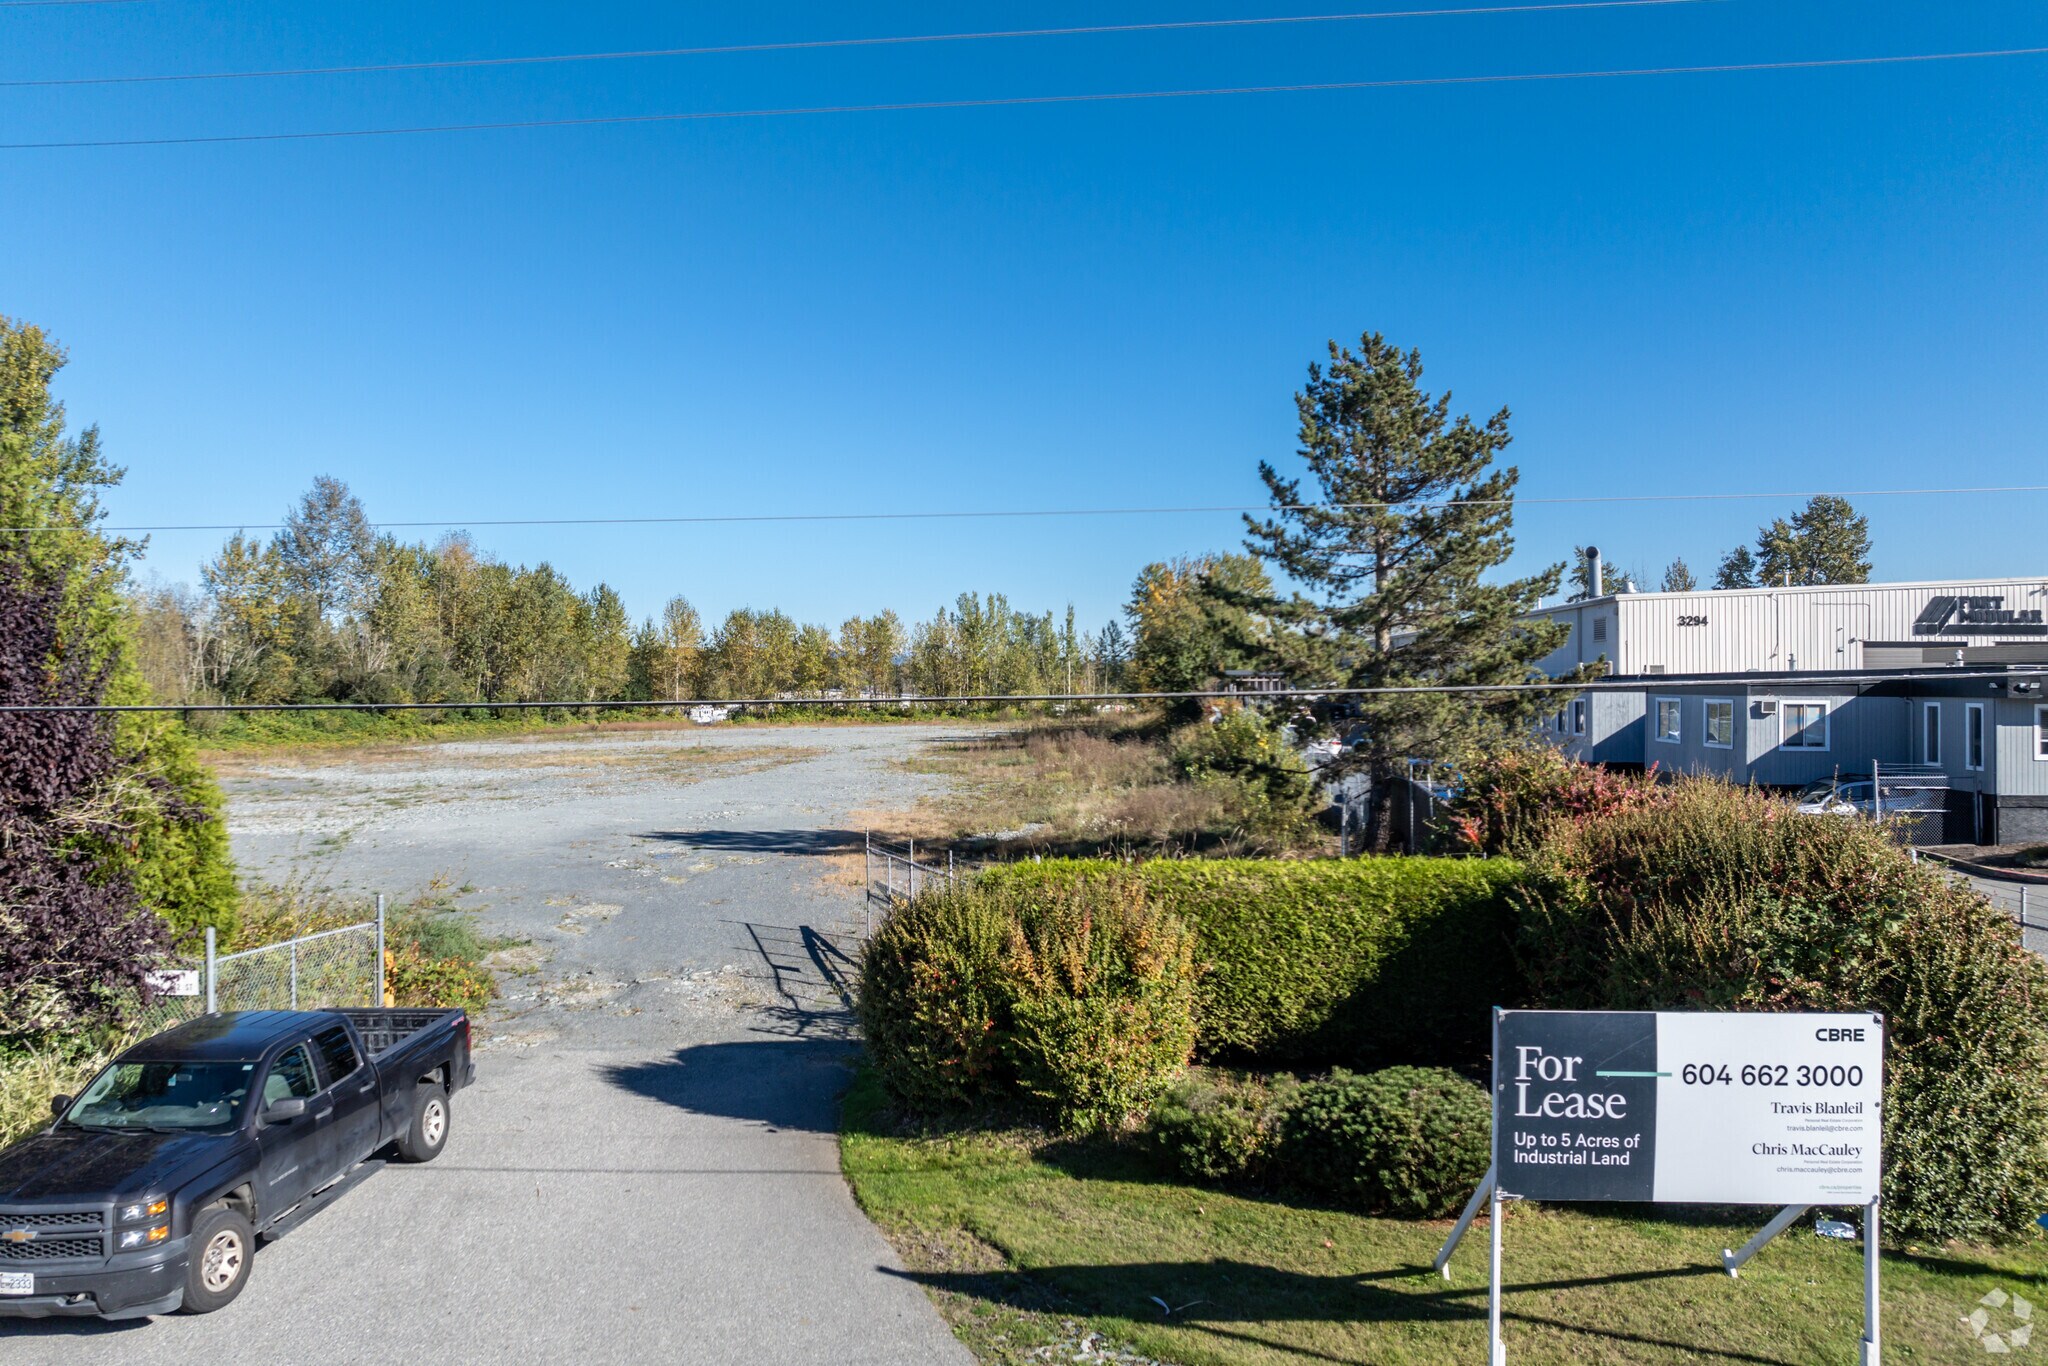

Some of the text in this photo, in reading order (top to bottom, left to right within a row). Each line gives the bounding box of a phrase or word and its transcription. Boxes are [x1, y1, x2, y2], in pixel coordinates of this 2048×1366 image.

[1958, 596, 2004, 609] FORT
[1677, 615, 1708, 627] 3294
[1958, 610, 2043, 623] MODULAR
[1815, 1028, 1865, 1042] CBRE
[1515, 1046, 1582, 1081] For
[1682, 1064, 1863, 1086] 604 662 3000
[1514, 1082, 1626, 1118] Lease
[1771, 1102, 1863, 1114] Travis Blanleil
[1514, 1132, 1640, 1148] Up to 5 Acres of
[1514, 1150, 1630, 1165] Industrial Land
[1752, 1143, 1863, 1159] Chris MacCauley
[1776, 1166, 1863, 1174] chris.maccauley@cbre.com
